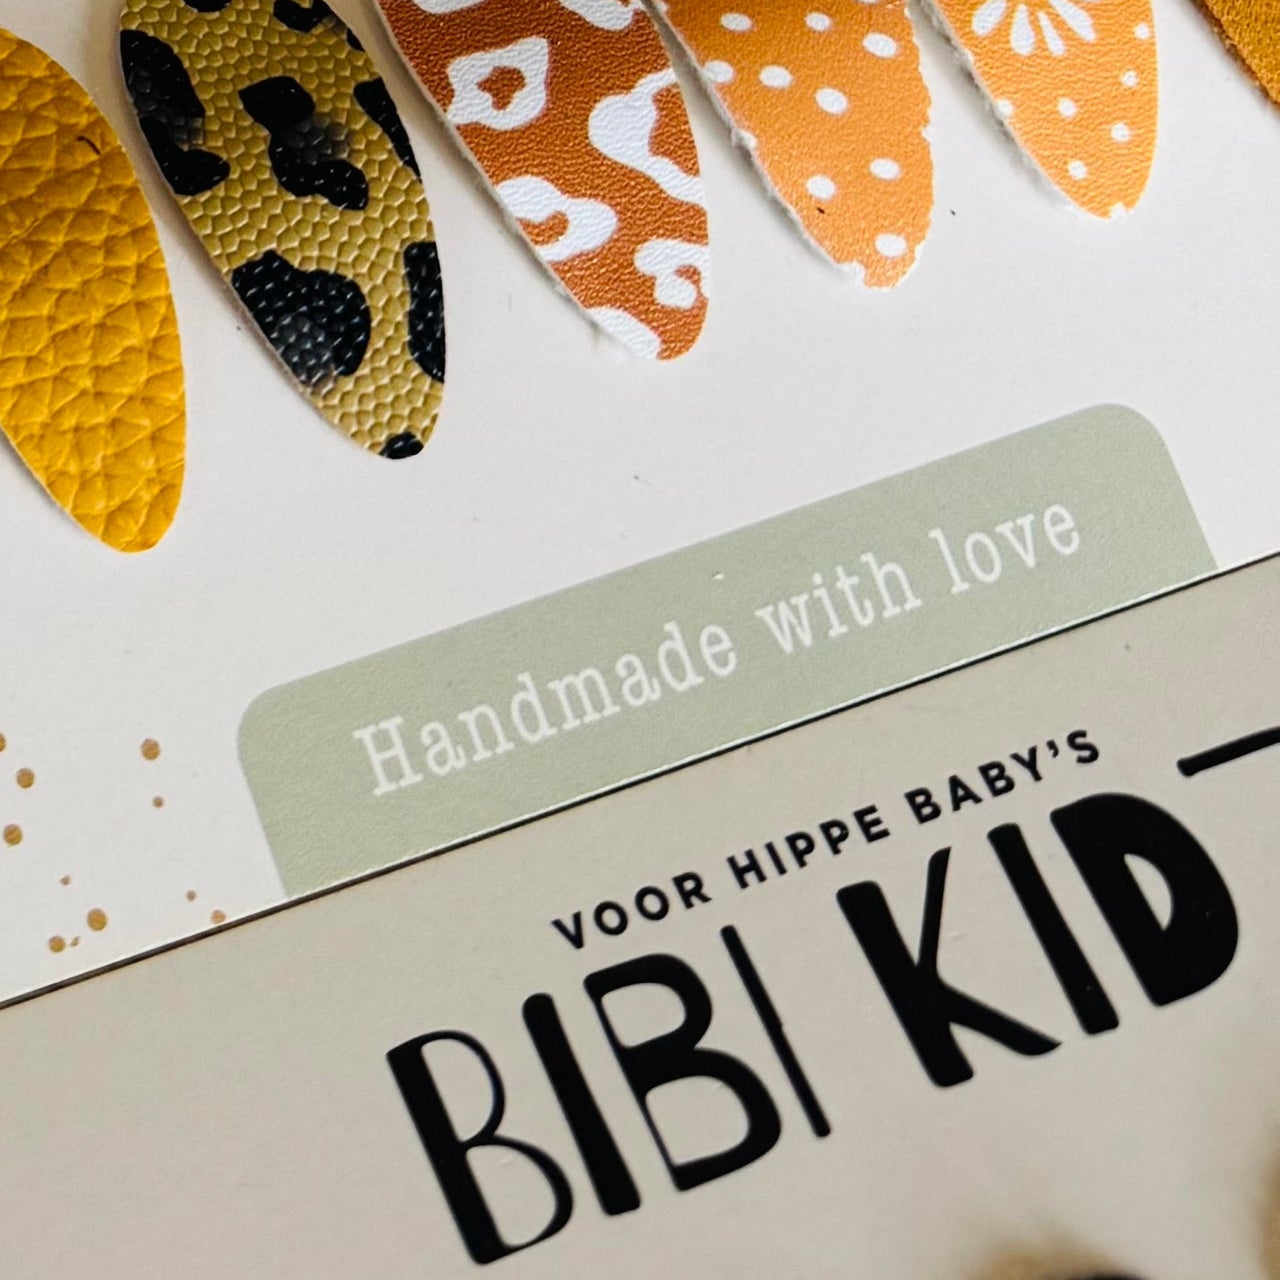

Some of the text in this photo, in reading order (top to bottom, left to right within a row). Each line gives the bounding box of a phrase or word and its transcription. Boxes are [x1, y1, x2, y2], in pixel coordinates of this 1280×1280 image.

[352, 502, 1082, 798] Handmade with love
[551, 728, 1101, 950] VOOR HIPPE BABY'S
[385, 924, 831, 1266] BIBI
